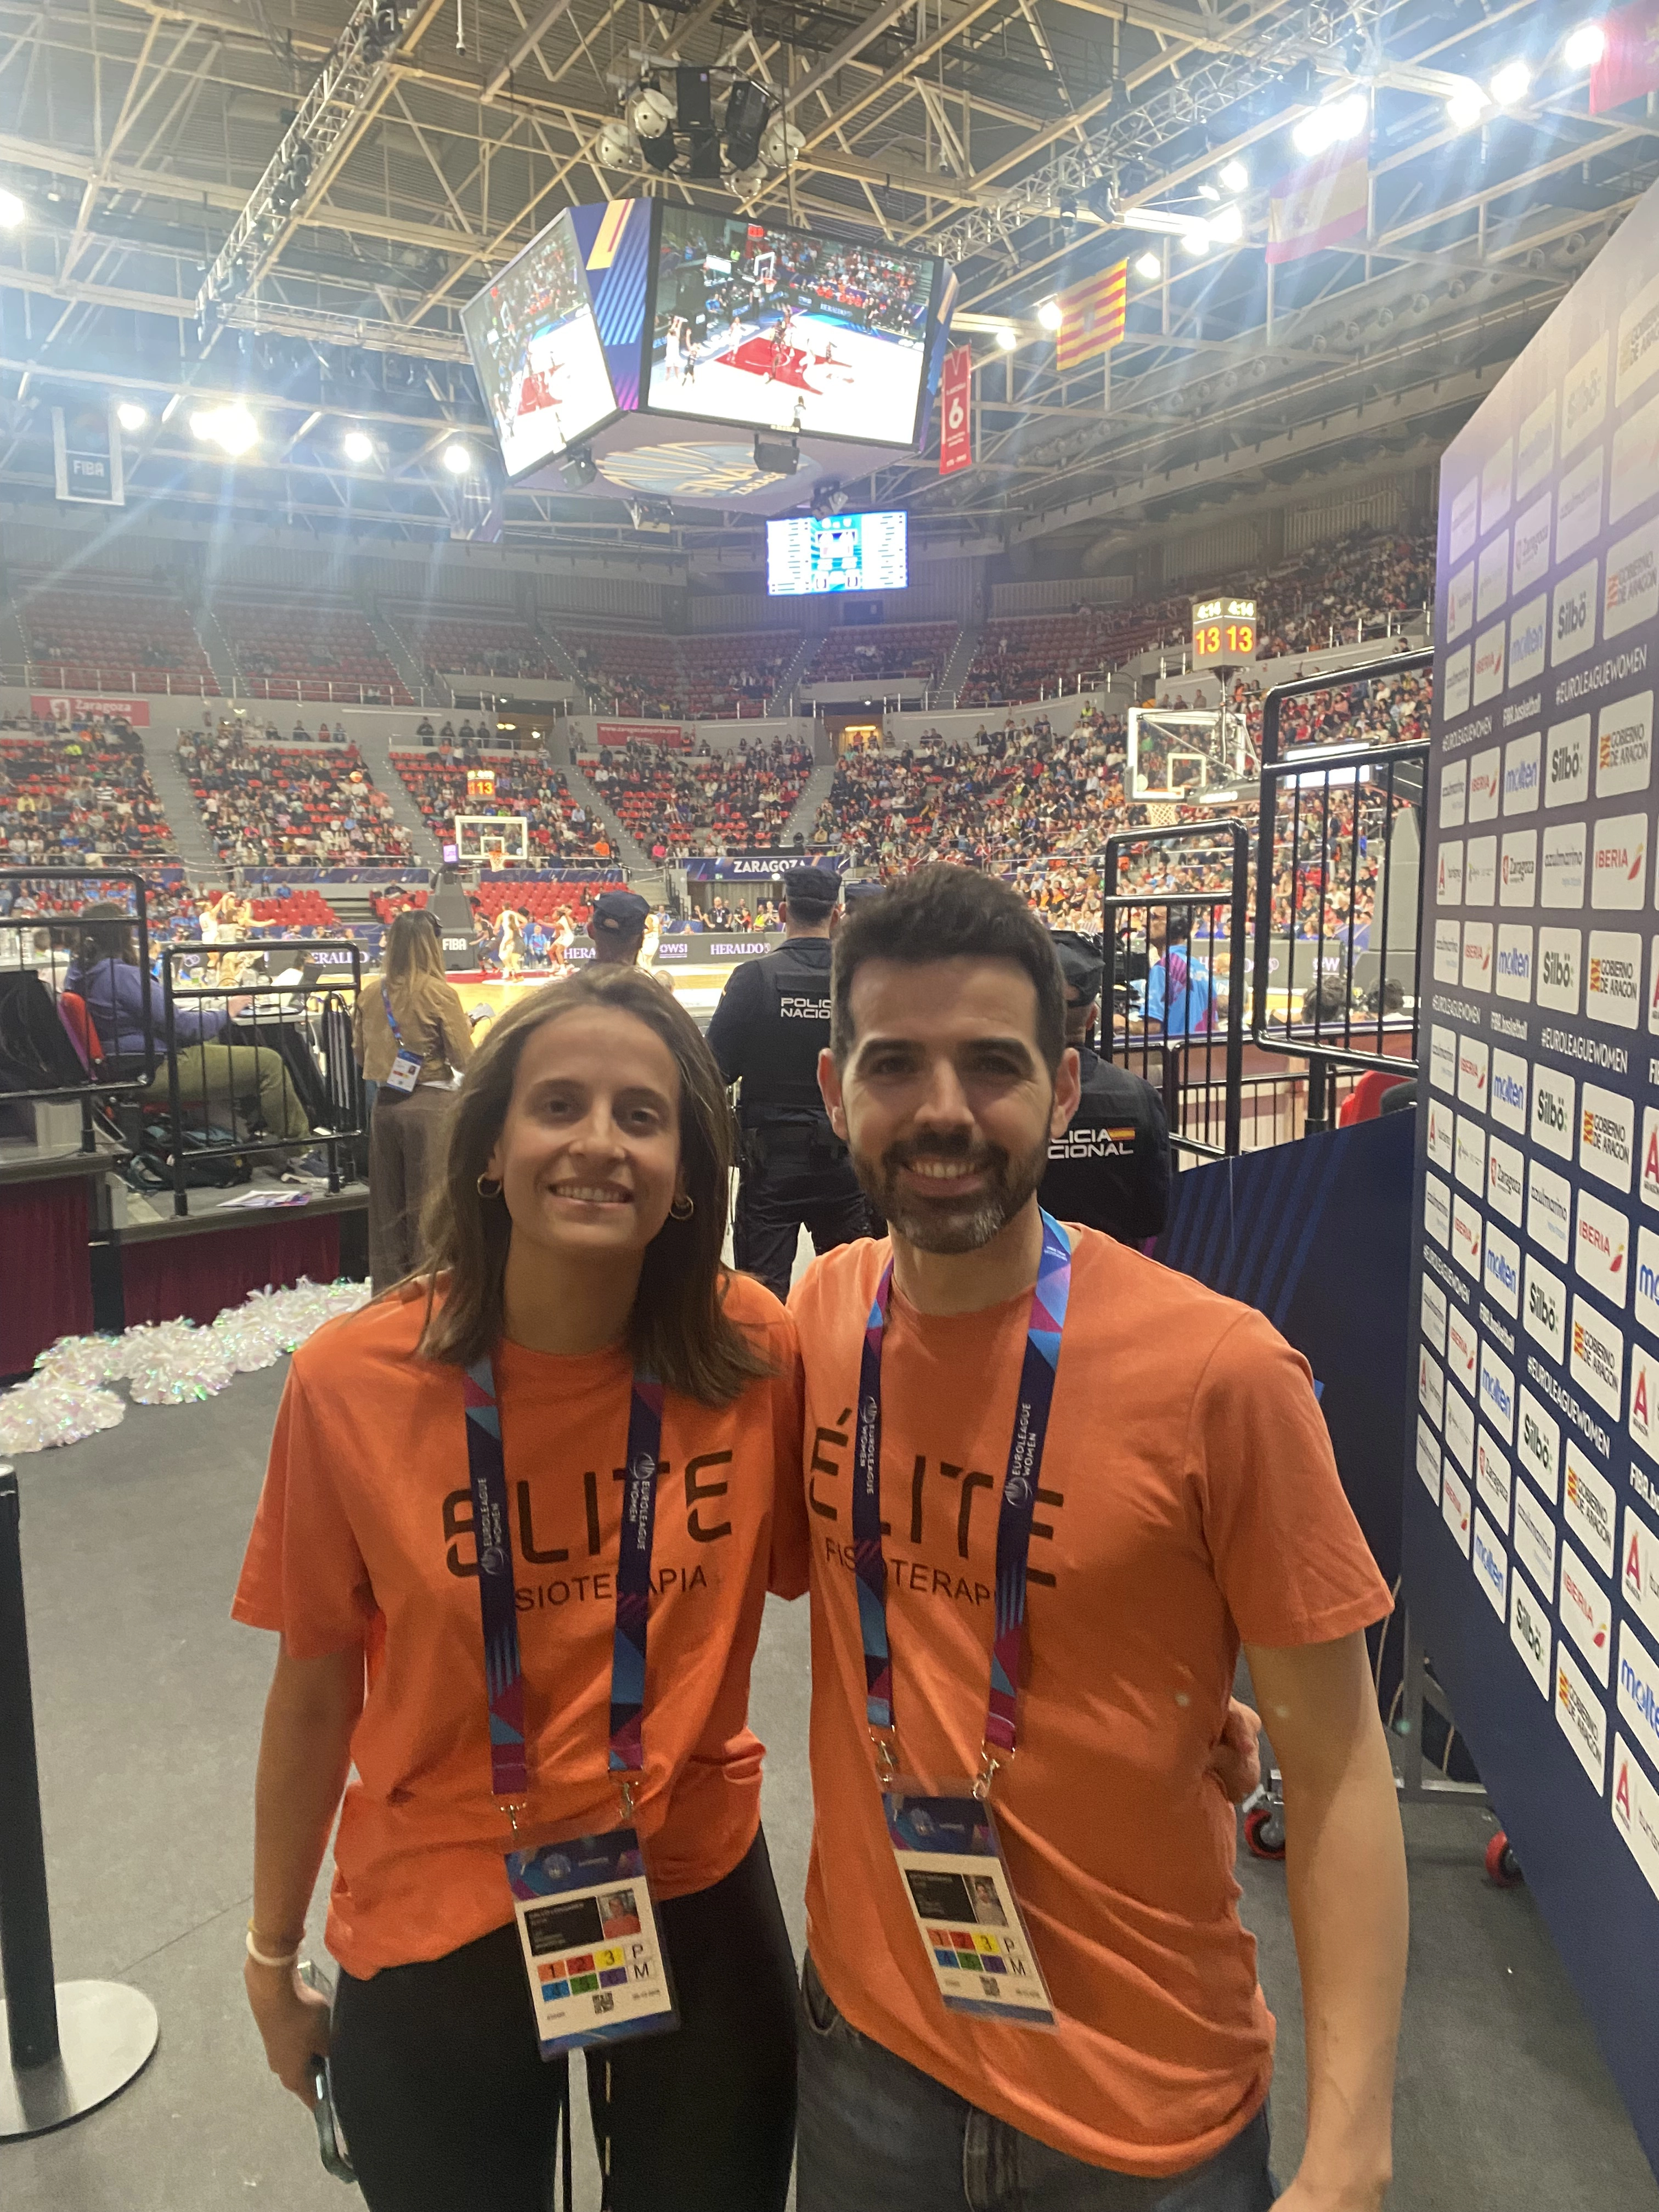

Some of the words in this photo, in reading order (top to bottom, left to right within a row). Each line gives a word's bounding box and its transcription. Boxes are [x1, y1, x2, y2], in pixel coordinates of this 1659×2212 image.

[949, 397, 964, 430] 6
[73, 460, 104, 477] FIBA
[1197, 601, 1221, 619] 4:14
[1228, 601, 1254, 617] 4:14
[1558, 591, 1587, 640] Silbö
[1196, 629, 1220, 654] 13
[1227, 625, 1252, 652] 13
[1555, 644, 1647, 706] #EUROLEAGUEWOMEN
[75, 699, 132, 713] Zaragoza
[1551, 743, 1579, 783] Silbö
[1595, 849, 1628, 871] IBERIA
[442, 938, 467, 951] FIBA
[710, 943, 764, 955] HERALDO
[1497, 947, 1530, 979] molten
[1543, 951, 1570, 988] Silbö
[1601, 959, 1634, 979] GOBIERNO
[1600, 977, 1609, 994] DE
[780, 1008, 831, 1019] NACIO
[781, 997, 832, 1009] POLIC
[1541, 1026, 1628, 1076] #EUROLEAGUEWOMEN
[1493, 1075, 1524, 1111] molten
[1538, 1088, 1564, 1132] Silbö
[1594, 1114, 1626, 1143] GOBIERNO
[1048, 1142, 1133, 1159] CIONAL
[1593, 1131, 1601, 1150] DE
[1579, 1218, 1610, 1257] IBERIA
[1486, 1249, 1516, 1296] molten
[1530, 1282, 1556, 1333] Silbö
[1012, 1402, 1031, 1476] EUROLEAGUE
[1022, 1432, 1036, 1476] WOMEN
[605, 1949, 614, 1966] 3
[632, 1944, 644, 1959] P
[1005, 1937, 1015, 1953] P
[635, 1962, 649, 1979] M
[1011, 1959, 1026, 1976] M
